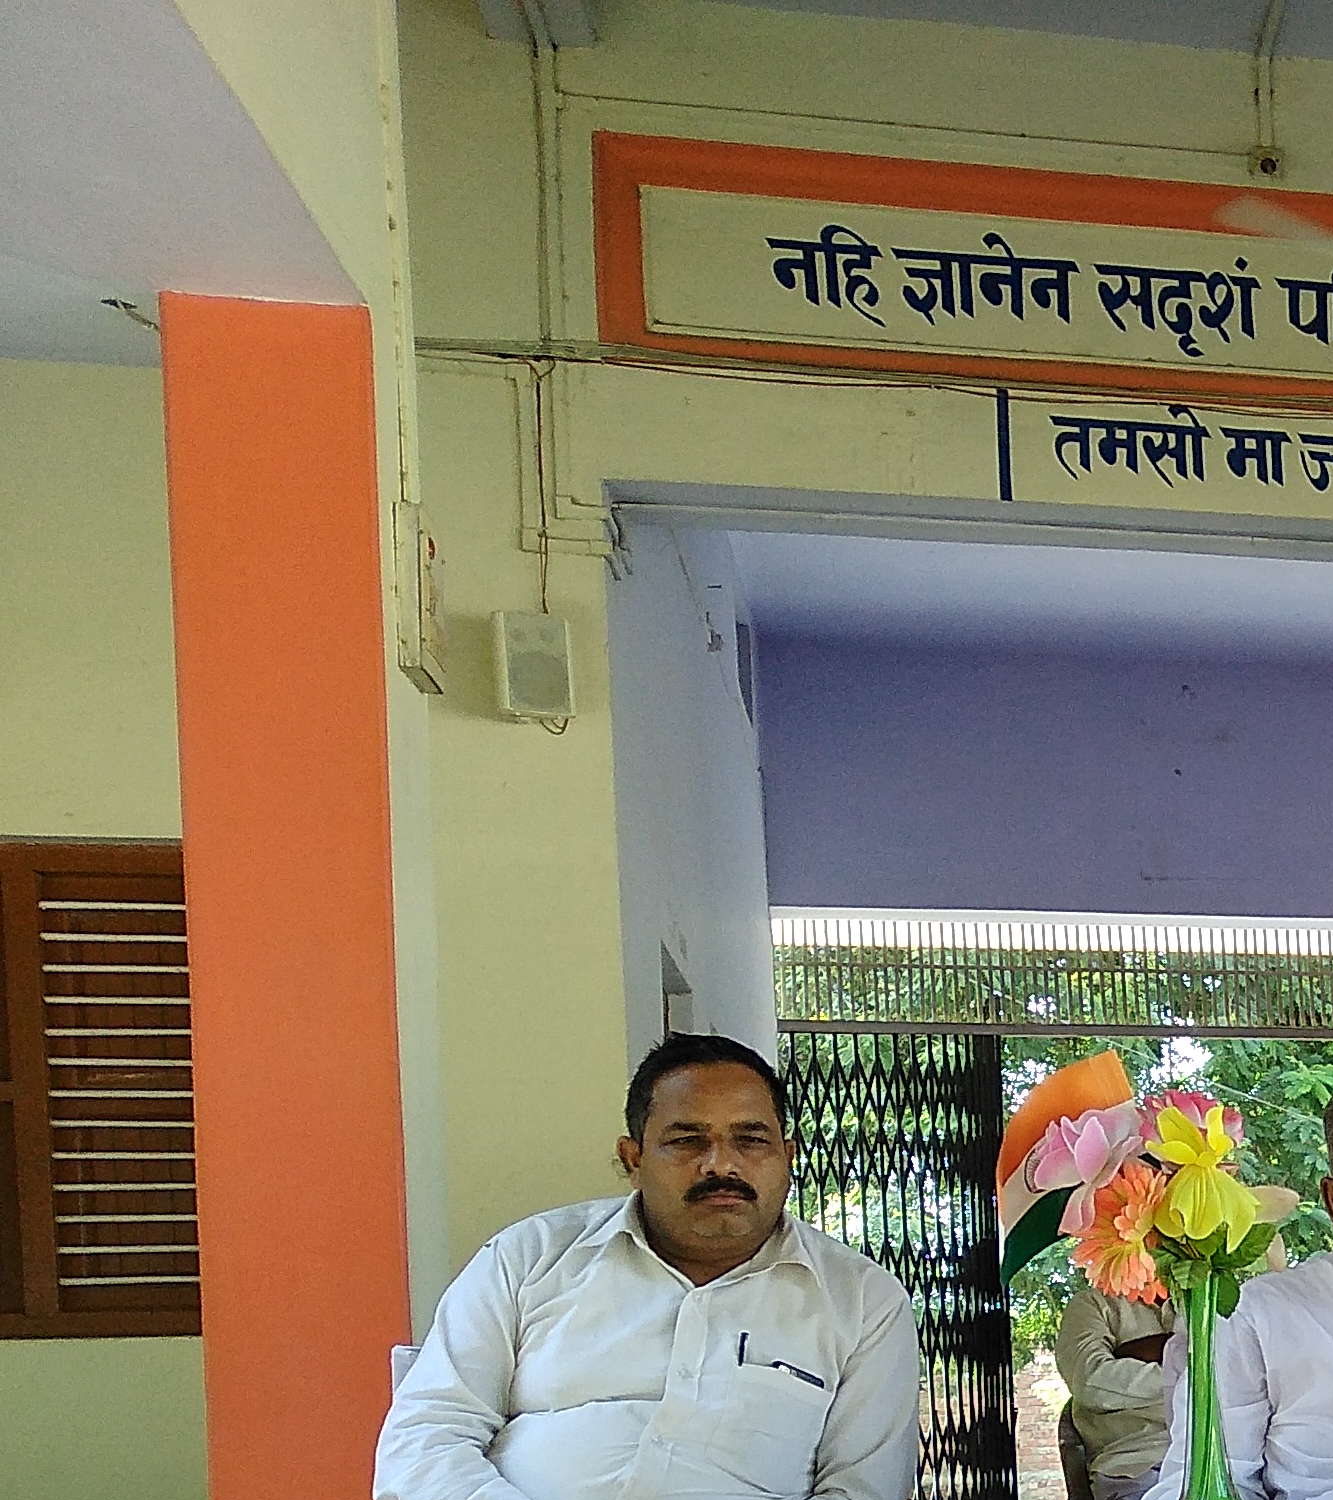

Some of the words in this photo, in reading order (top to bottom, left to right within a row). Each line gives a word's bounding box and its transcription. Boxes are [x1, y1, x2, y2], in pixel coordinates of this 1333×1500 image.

[766, 223, 885, 327] नहि
[889, 232, 1080, 326] ज्ञानेन
[1093, 255, 1261, 356] सदृशं
[1049, 406, 1211, 488] तमसो
[1219, 426, 1292, 486] मा
